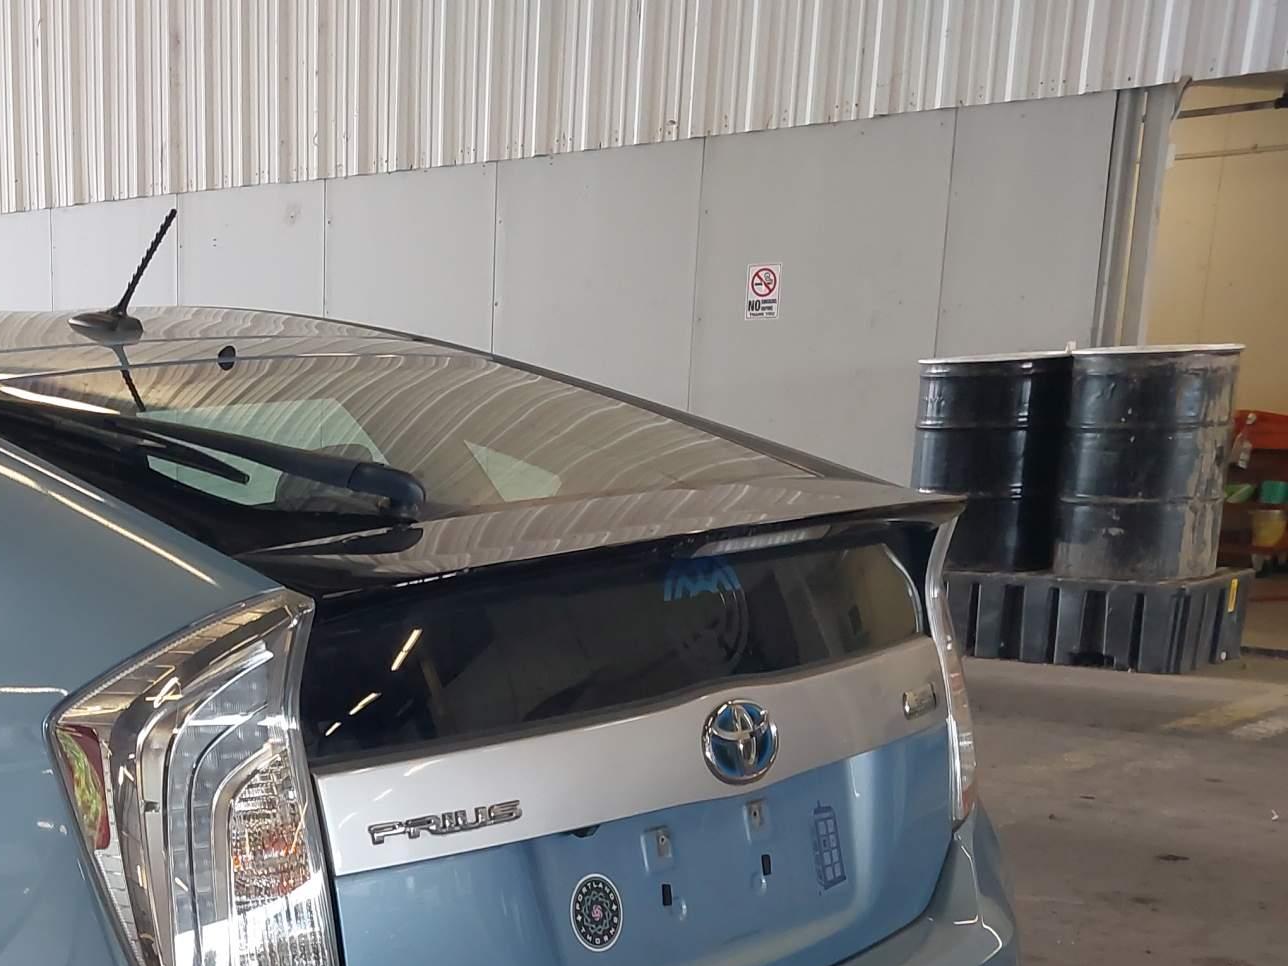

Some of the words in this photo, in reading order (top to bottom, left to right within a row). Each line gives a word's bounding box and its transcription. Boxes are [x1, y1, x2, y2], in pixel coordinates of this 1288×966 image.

[748, 300, 760, 311] NO
[368, 800, 523, 846] PRIUS
[576, 881, 615, 911] PORTLAND
[580, 916, 619, 945] THORNS
